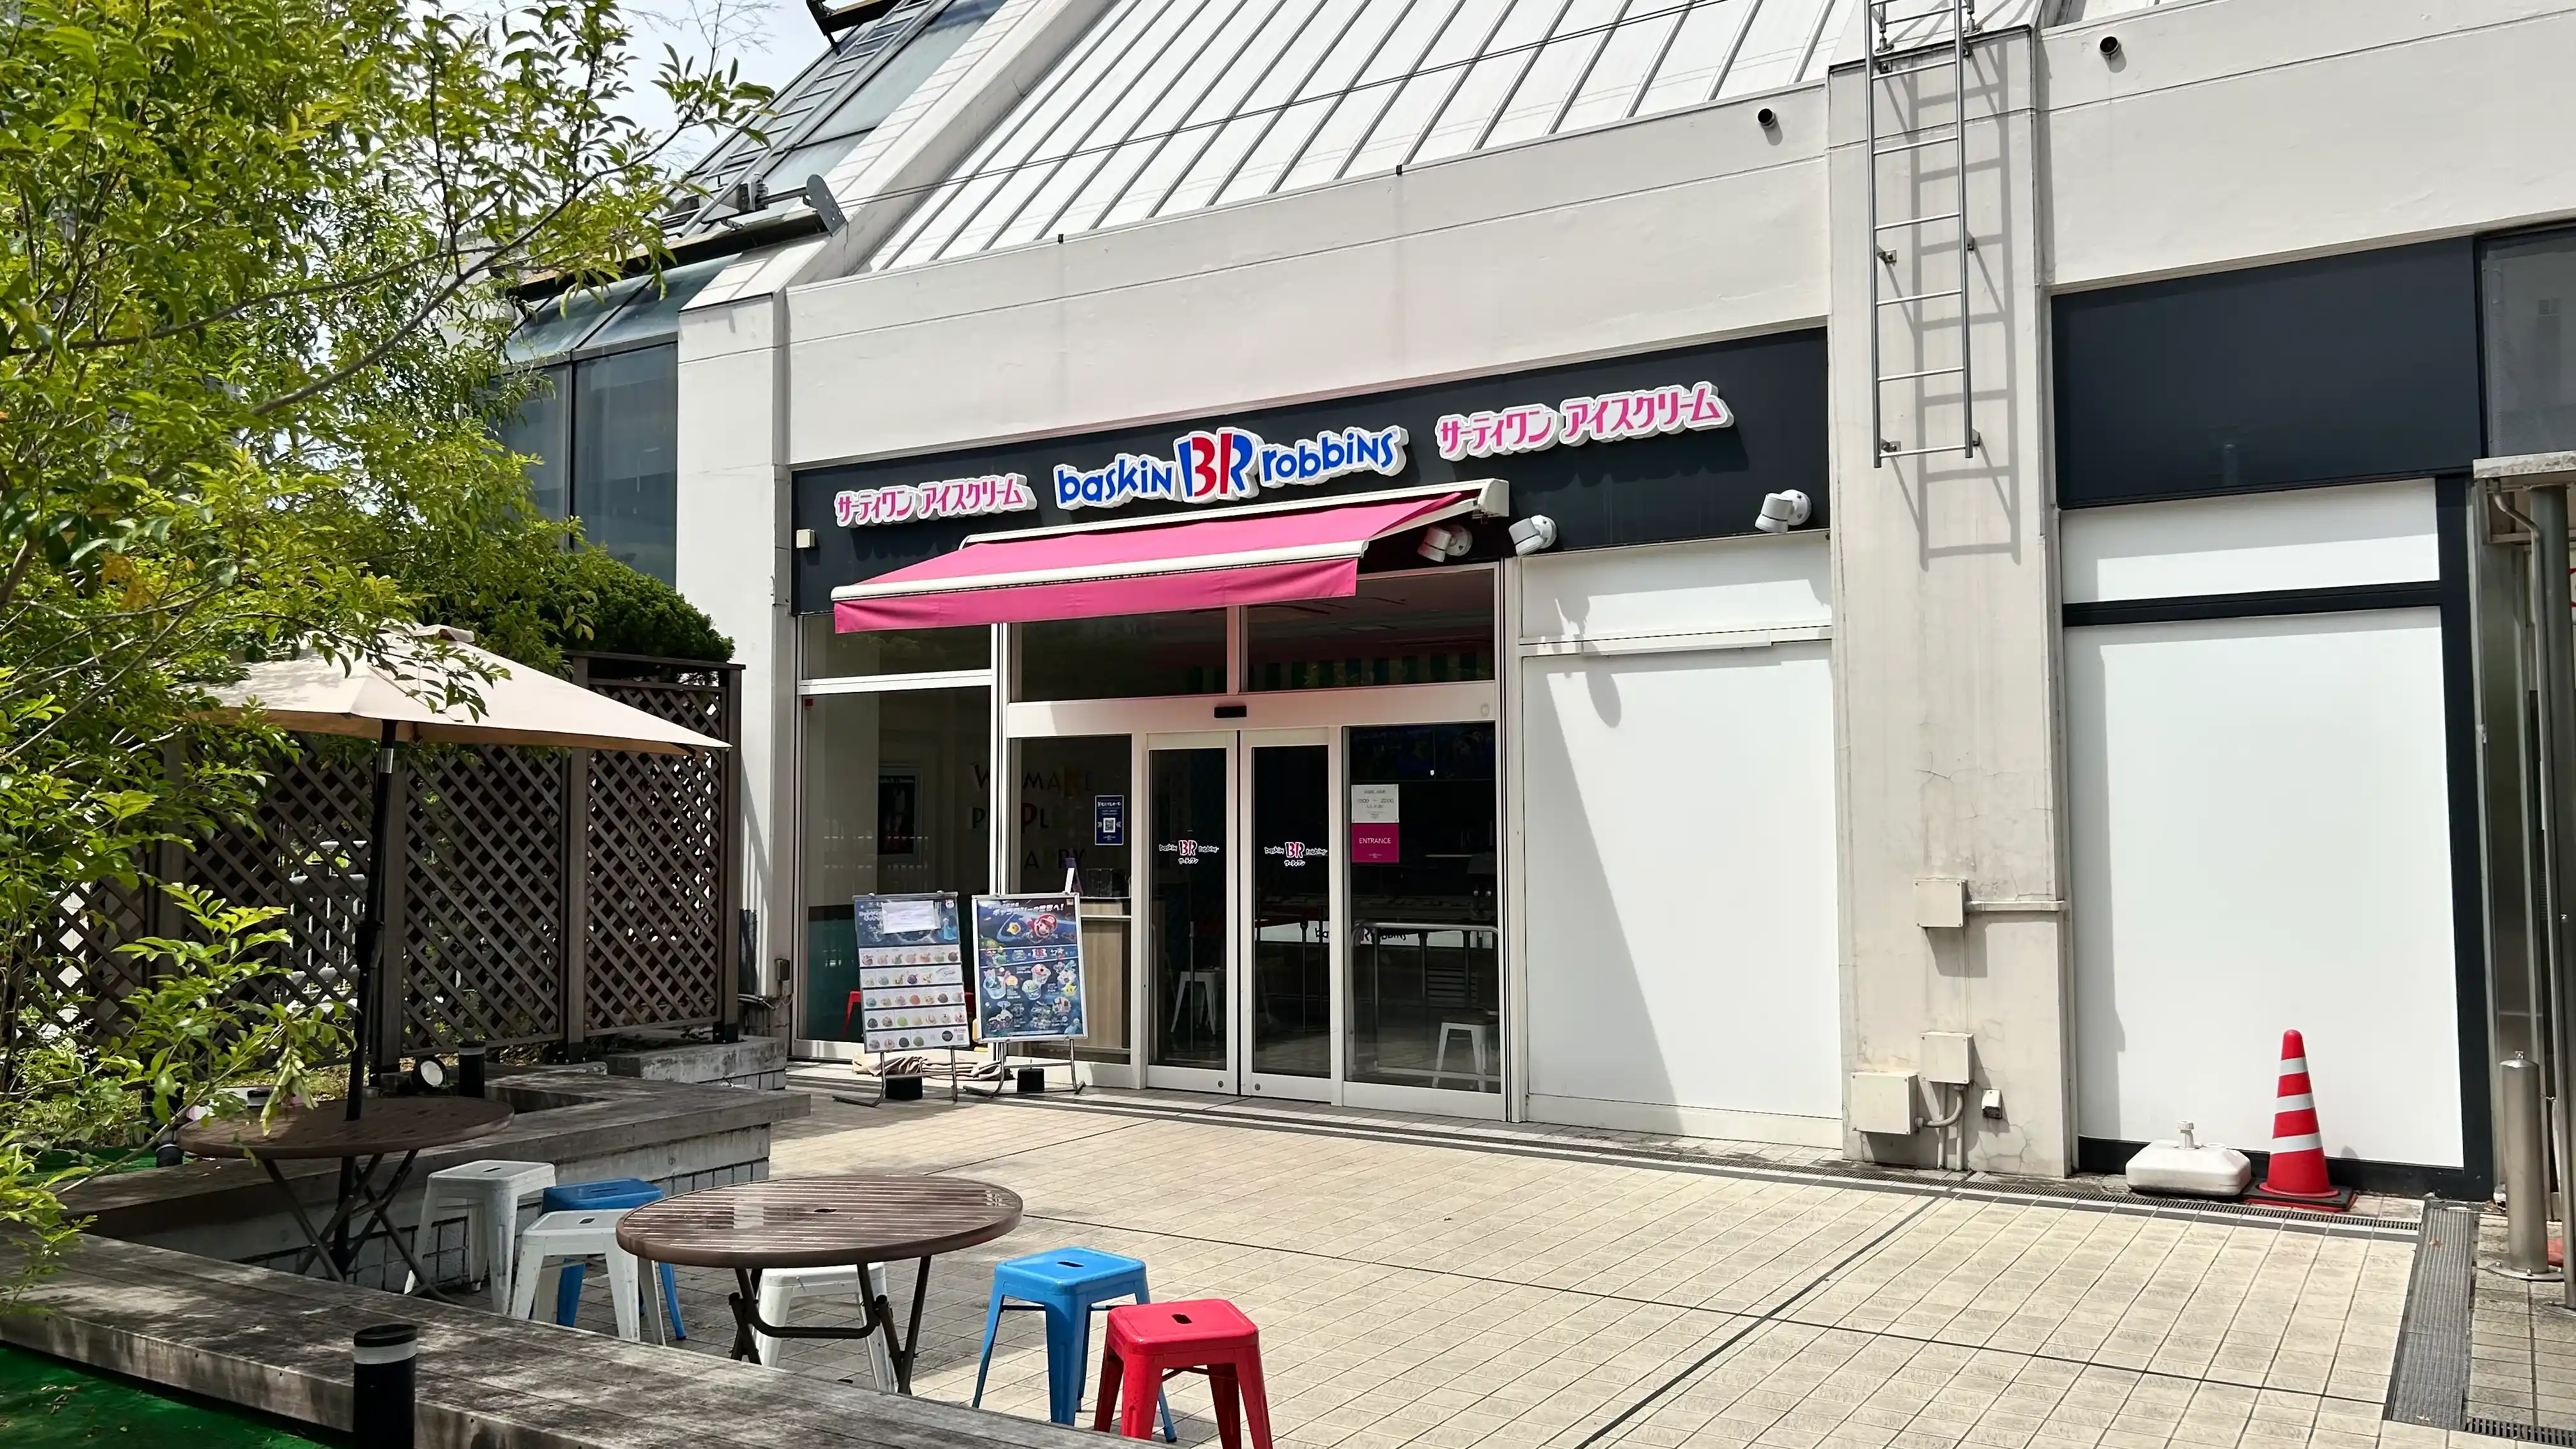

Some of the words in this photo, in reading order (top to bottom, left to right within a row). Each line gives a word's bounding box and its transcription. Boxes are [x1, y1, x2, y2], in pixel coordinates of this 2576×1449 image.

[1439, 409, 1551, 454] サーティワン
[1565, 387, 1722, 439] アイスクリーム
[1176, 432, 1256, 498] BR
[838, 489, 914, 523] サーティワン
[921, 477, 1026, 516] アイスクリーム
[1178, 839, 1198, 856] BR
[1284, 841, 1305, 859] BR
